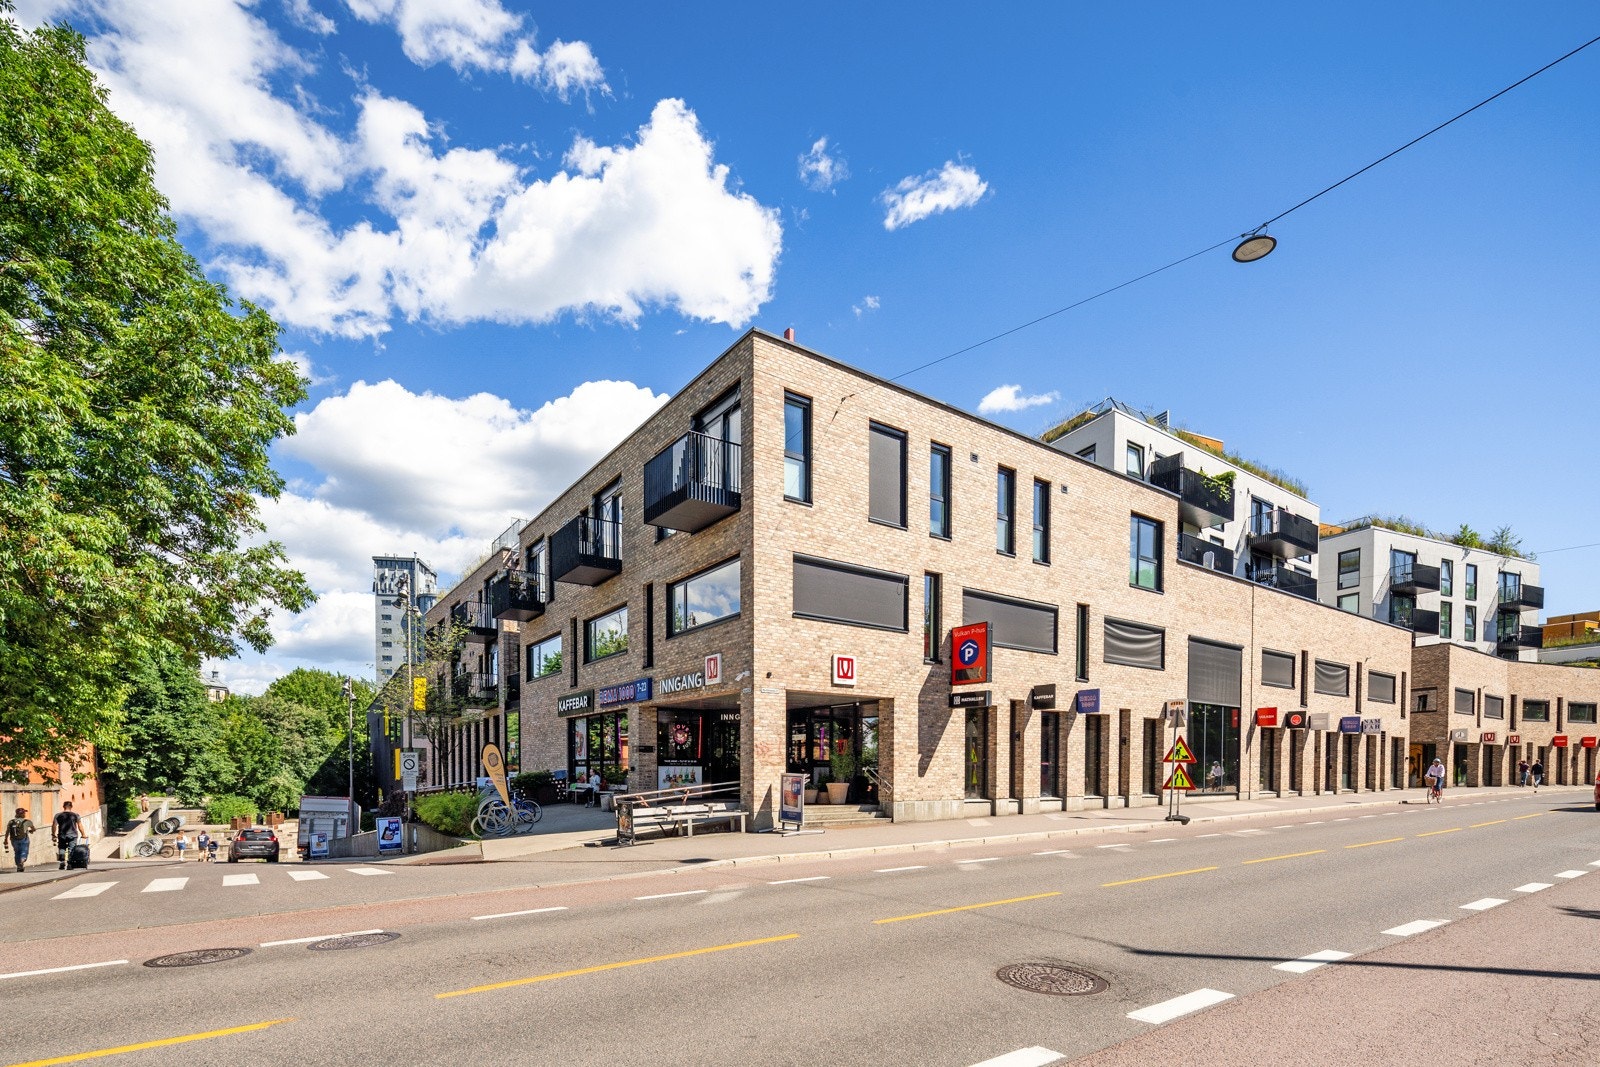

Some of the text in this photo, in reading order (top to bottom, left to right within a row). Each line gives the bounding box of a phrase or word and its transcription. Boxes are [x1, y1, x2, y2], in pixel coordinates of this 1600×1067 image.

[637, 682, 647, 692] 7-23
[659, 672, 702, 694] INNGANG
[619, 685, 634, 700] 1000
[558, 695, 588, 712] KAFFEBAR
[720, 713, 741, 721] INNG
